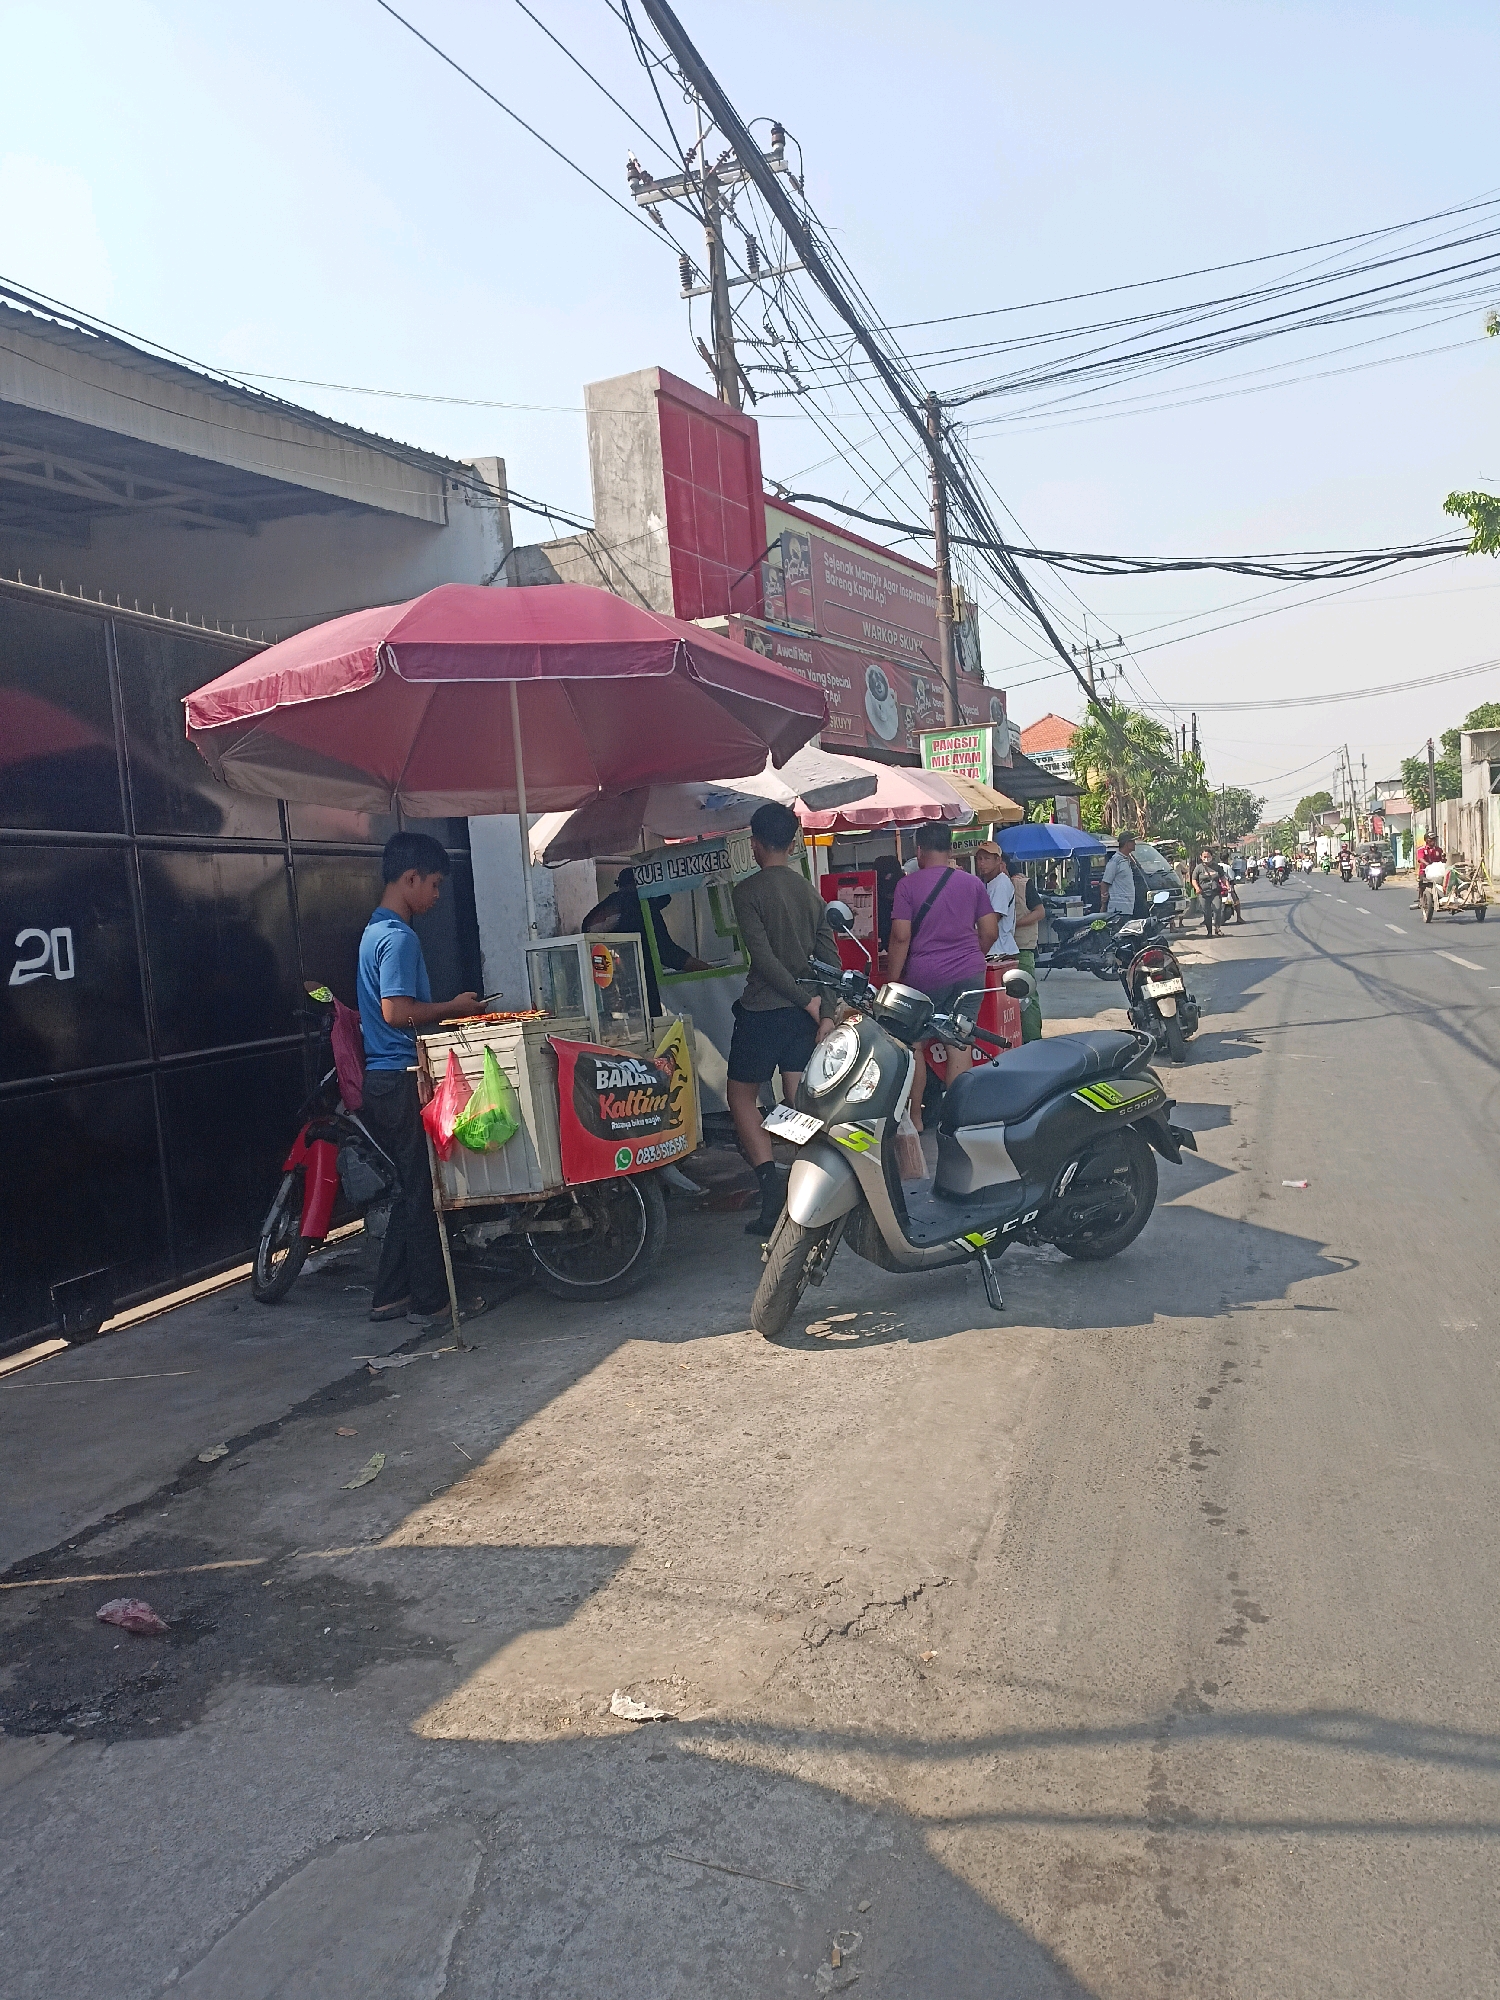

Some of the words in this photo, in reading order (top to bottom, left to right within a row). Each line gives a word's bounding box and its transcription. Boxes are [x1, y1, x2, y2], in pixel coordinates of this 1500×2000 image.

[823, 551, 854, 576] Sejenak
[854, 564, 882, 589] Mampir
[883, 577, 899, 596] Agar
[899, 583, 926, 605] Inspirasi
[825, 569, 853, 597] Bareng
[853, 580, 875, 601] Kapal
[875, 589, 887, 608] Api
[862, 620, 898, 646] WARKOP
[899, 633, 924, 654] SKUYY
[776, 643, 797, 660] Awali
[798, 648, 813, 663] Hari
[807, 668, 827, 687] Yang
[827, 672, 852, 690] Special
[829, 689, 842, 707] Api
[932, 736, 979, 752] PANGSIT
[931, 754, 951, 768] MIE
[952, 751, 981, 765] AYAM
[632, 861, 664, 886] KUE
[667, 849, 731, 880] LEKKER
[8, 927, 75, 986] 20
[598, 1087, 669, 1120] Kaltim
[1119, 1094, 1160, 1116] SCOOPY
